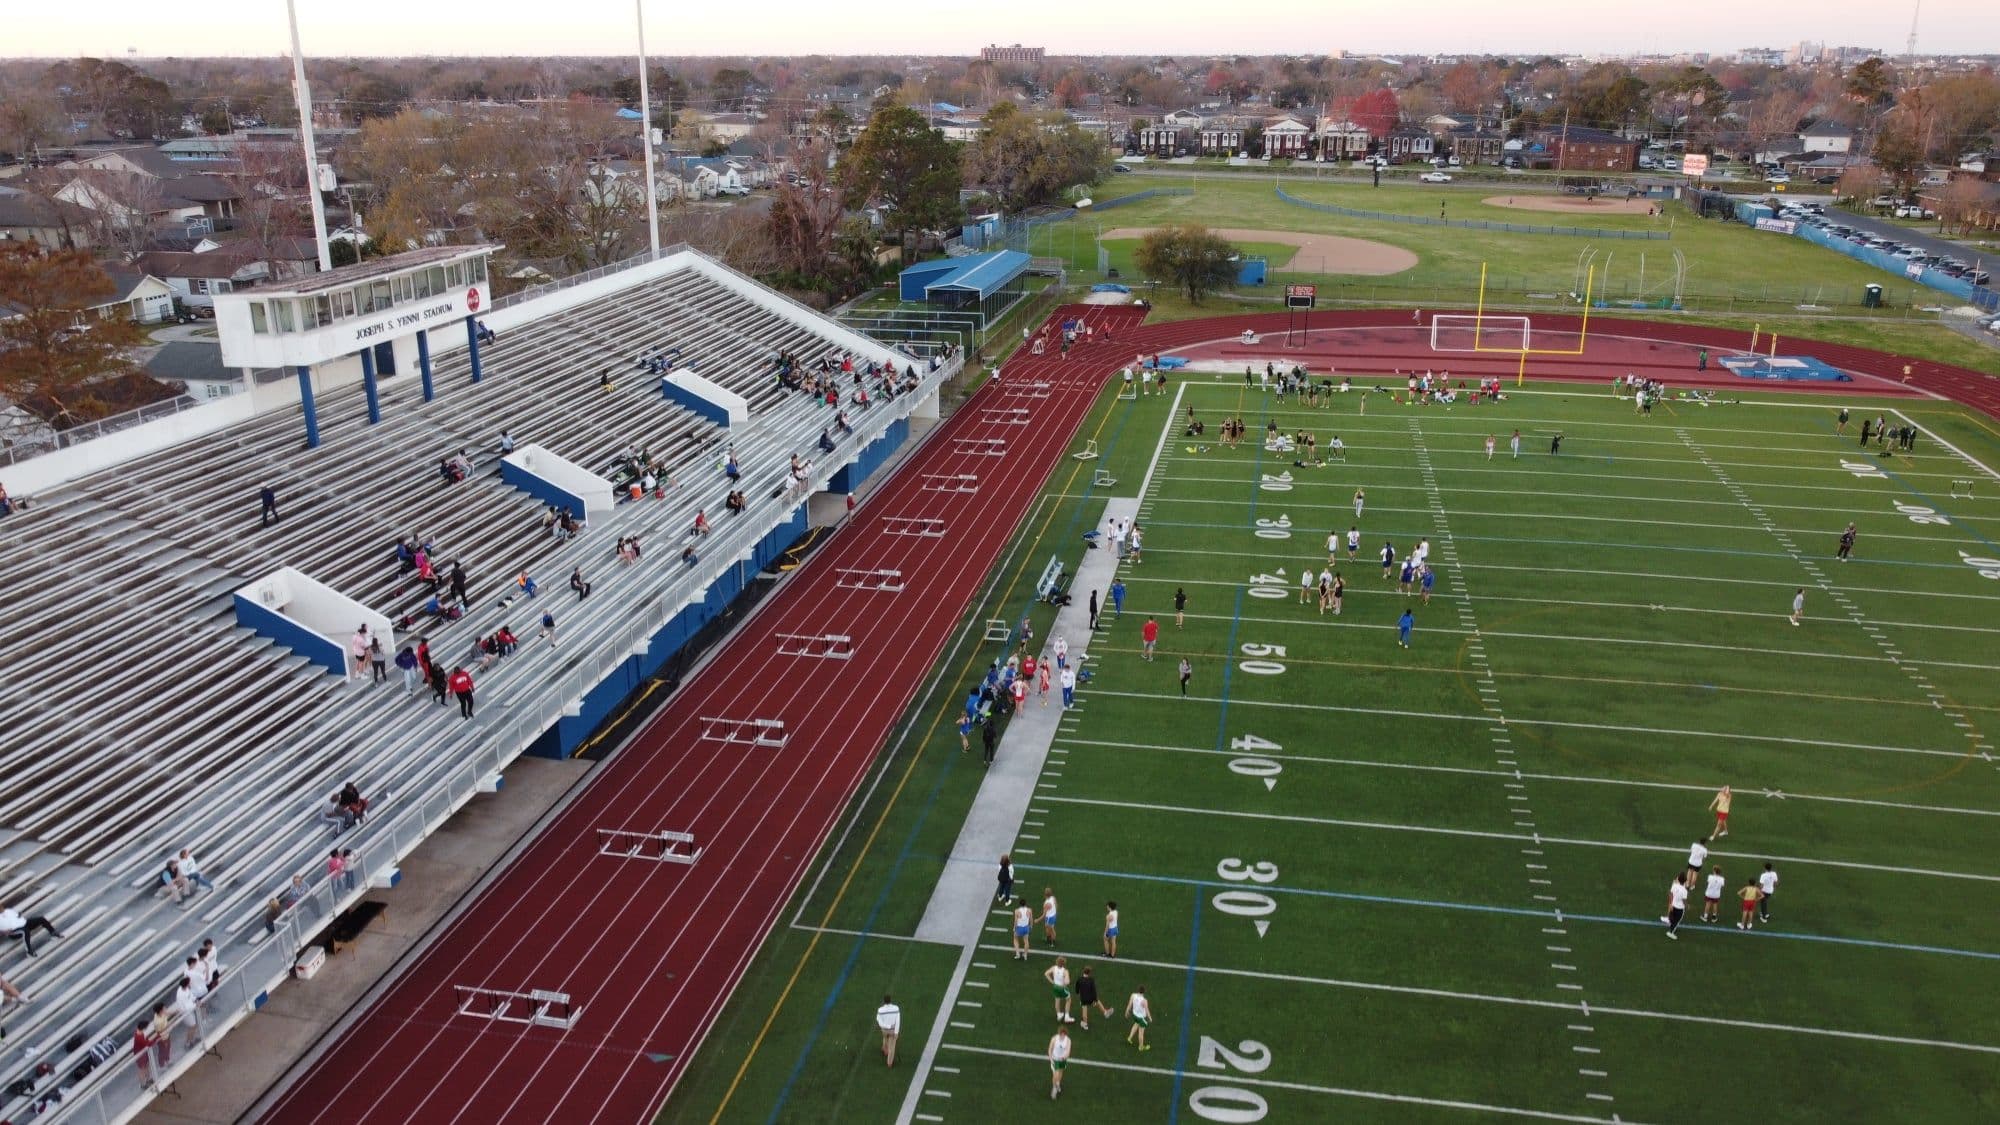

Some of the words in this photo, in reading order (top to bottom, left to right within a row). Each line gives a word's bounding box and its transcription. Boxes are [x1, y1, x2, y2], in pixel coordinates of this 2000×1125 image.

[356, 323, 384, 340] JOSEPH
[397, 313, 420, 326] YENNI
[423, 303, 453, 320] STADIUM
[1260, 474, 1294, 491] 20
[1842, 463, 1889, 479] 10
[1255, 518, 1292, 539] 30
[1896, 505, 1951, 526] 20
[1248, 573, 1289, 599] 40
[1239, 643, 1287, 675] 50
[1228, 734, 1283, 776] 40
[1212, 858, 1279, 917] 30
[1189, 1035, 1272, 1124] 20
